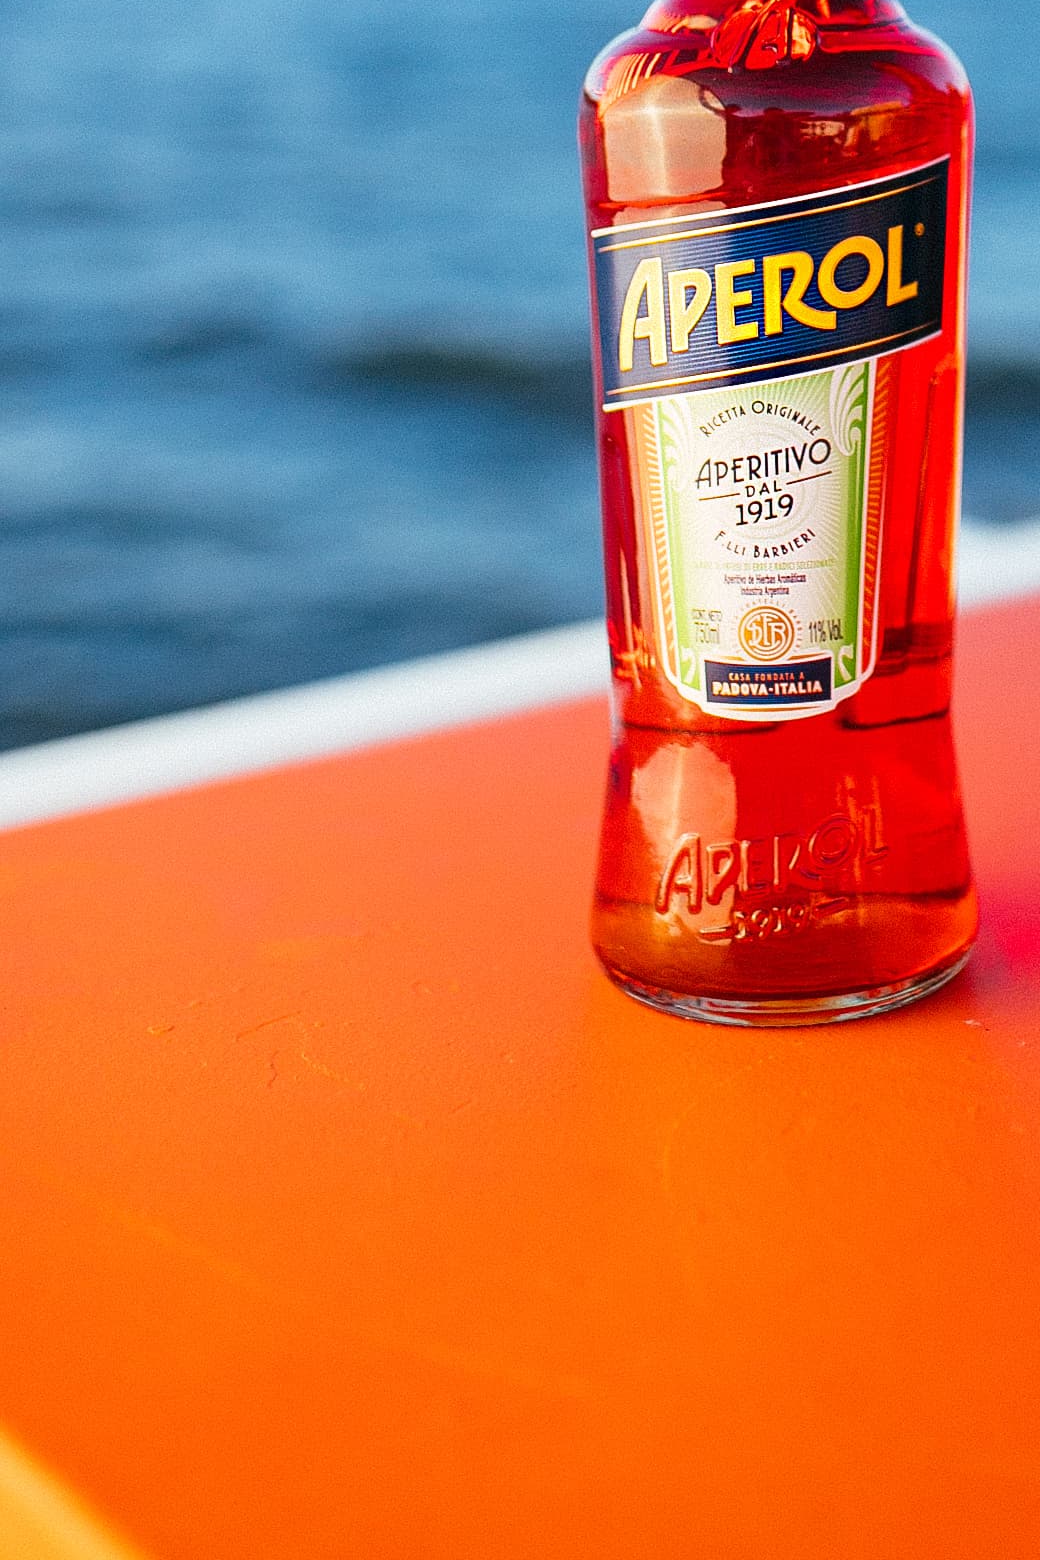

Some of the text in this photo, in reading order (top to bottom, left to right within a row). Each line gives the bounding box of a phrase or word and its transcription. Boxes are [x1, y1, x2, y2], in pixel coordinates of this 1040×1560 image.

[619, 225, 919, 373] APEROL
[700, 400, 821, 438] RICETTA ORIGINALE
[695, 438, 832, 489] APERITIVO
[745, 480, 782, 498] DAL
[735, 493, 794, 526] 1919
[753, 528, 816, 558] BARBIERI
[711, 680, 823, 697] PADOVA-ITALIA
[728, 672, 751, 681] CASA
[755, 672, 795, 681] FONDATA
